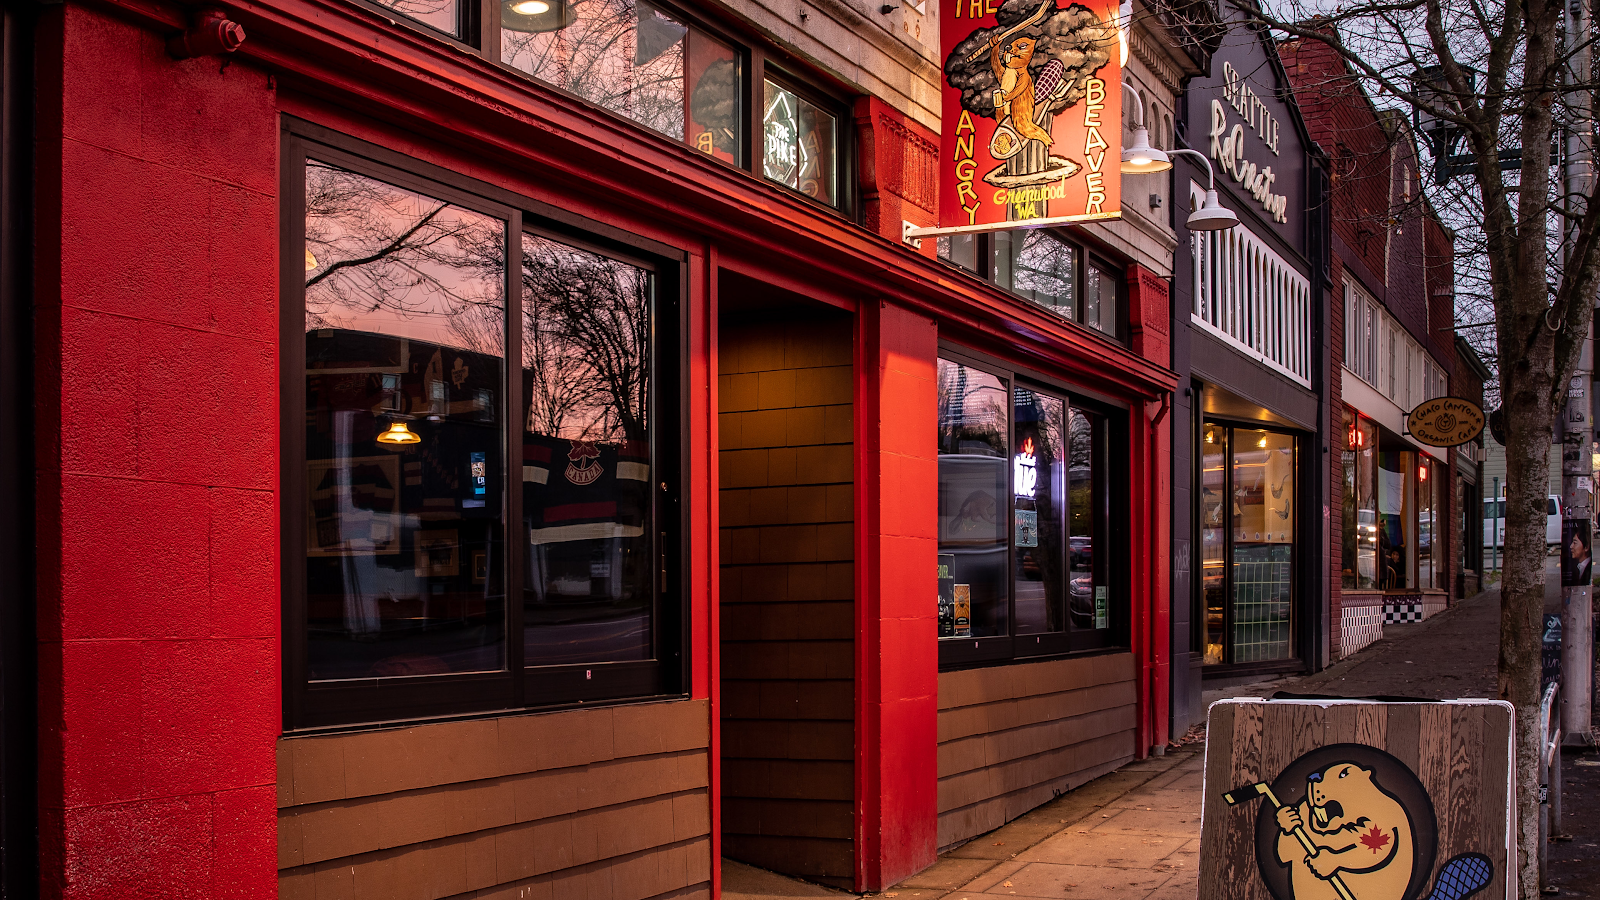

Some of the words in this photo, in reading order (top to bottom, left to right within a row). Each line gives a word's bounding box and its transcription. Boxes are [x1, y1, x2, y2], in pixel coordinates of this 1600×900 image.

[1222, 60, 1280, 157] SEATTLE
[766, 133, 798, 167] PIKE
[1083, 78, 1108, 214] BEAVER
[955, 109, 982, 226] ANGRY
[993, 174, 1067, 205] Greenwood
[1014, 201, 1040, 220] WA
[1415, 404, 1441, 421] CHACO
[1443, 400, 1477, 418] CANYON
[1417, 430, 1455, 444] ORGANIC
[566, 465, 601, 485] CANADA
